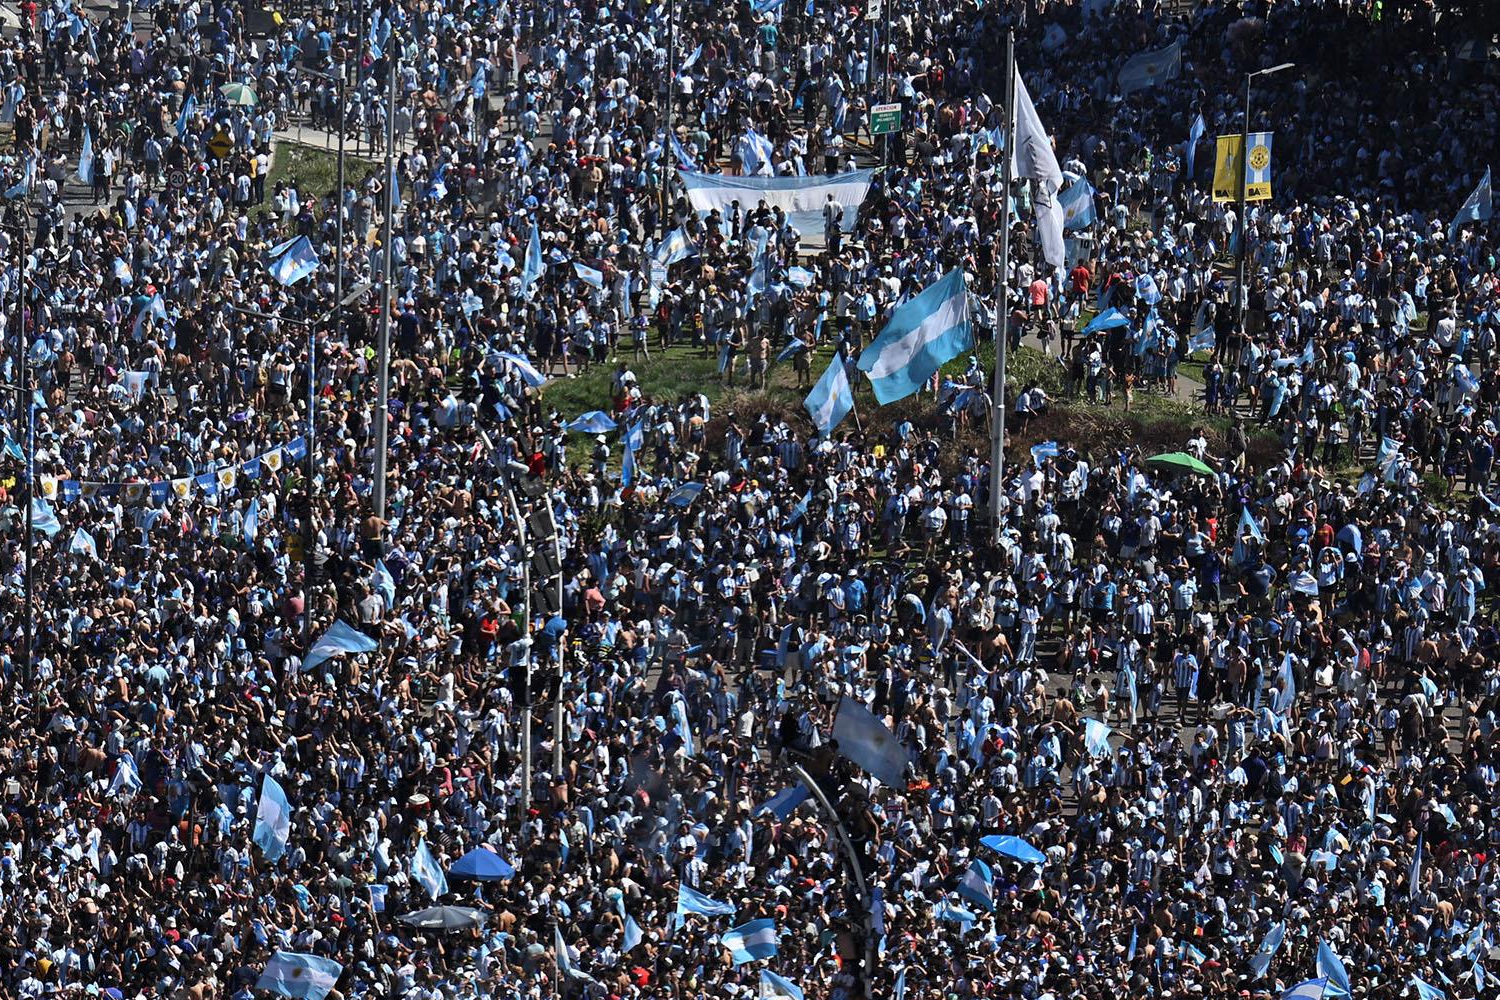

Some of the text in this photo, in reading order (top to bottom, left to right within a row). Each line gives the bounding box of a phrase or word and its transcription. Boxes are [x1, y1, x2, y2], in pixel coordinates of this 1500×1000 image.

[172, 174, 184, 184] 20
[1248, 187, 1260, 196] BA
[1080, 239, 1090, 249] 10
